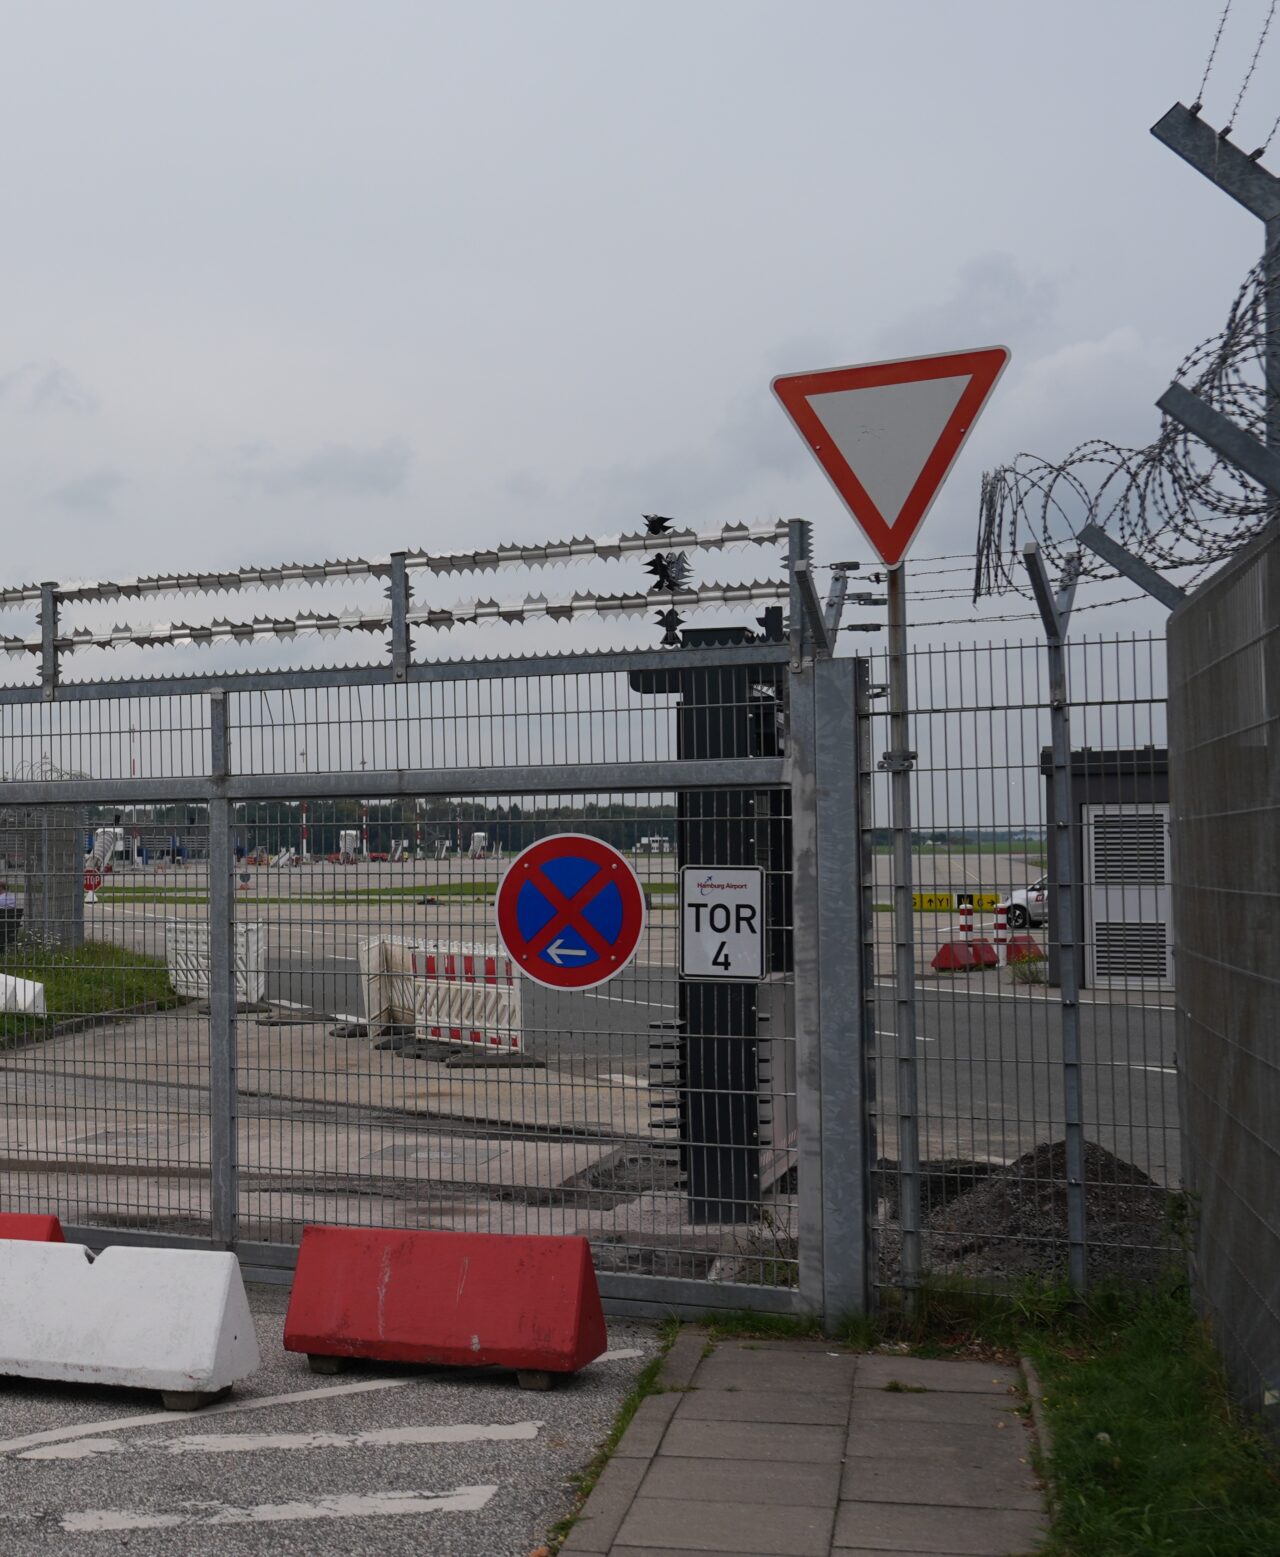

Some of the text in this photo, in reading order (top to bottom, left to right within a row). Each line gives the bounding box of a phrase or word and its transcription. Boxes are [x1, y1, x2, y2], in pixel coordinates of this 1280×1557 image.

[697, 882, 747, 890] Hamburg Airport
[687, 903, 757, 934] TOR
[711, 941, 731, 971] 4
